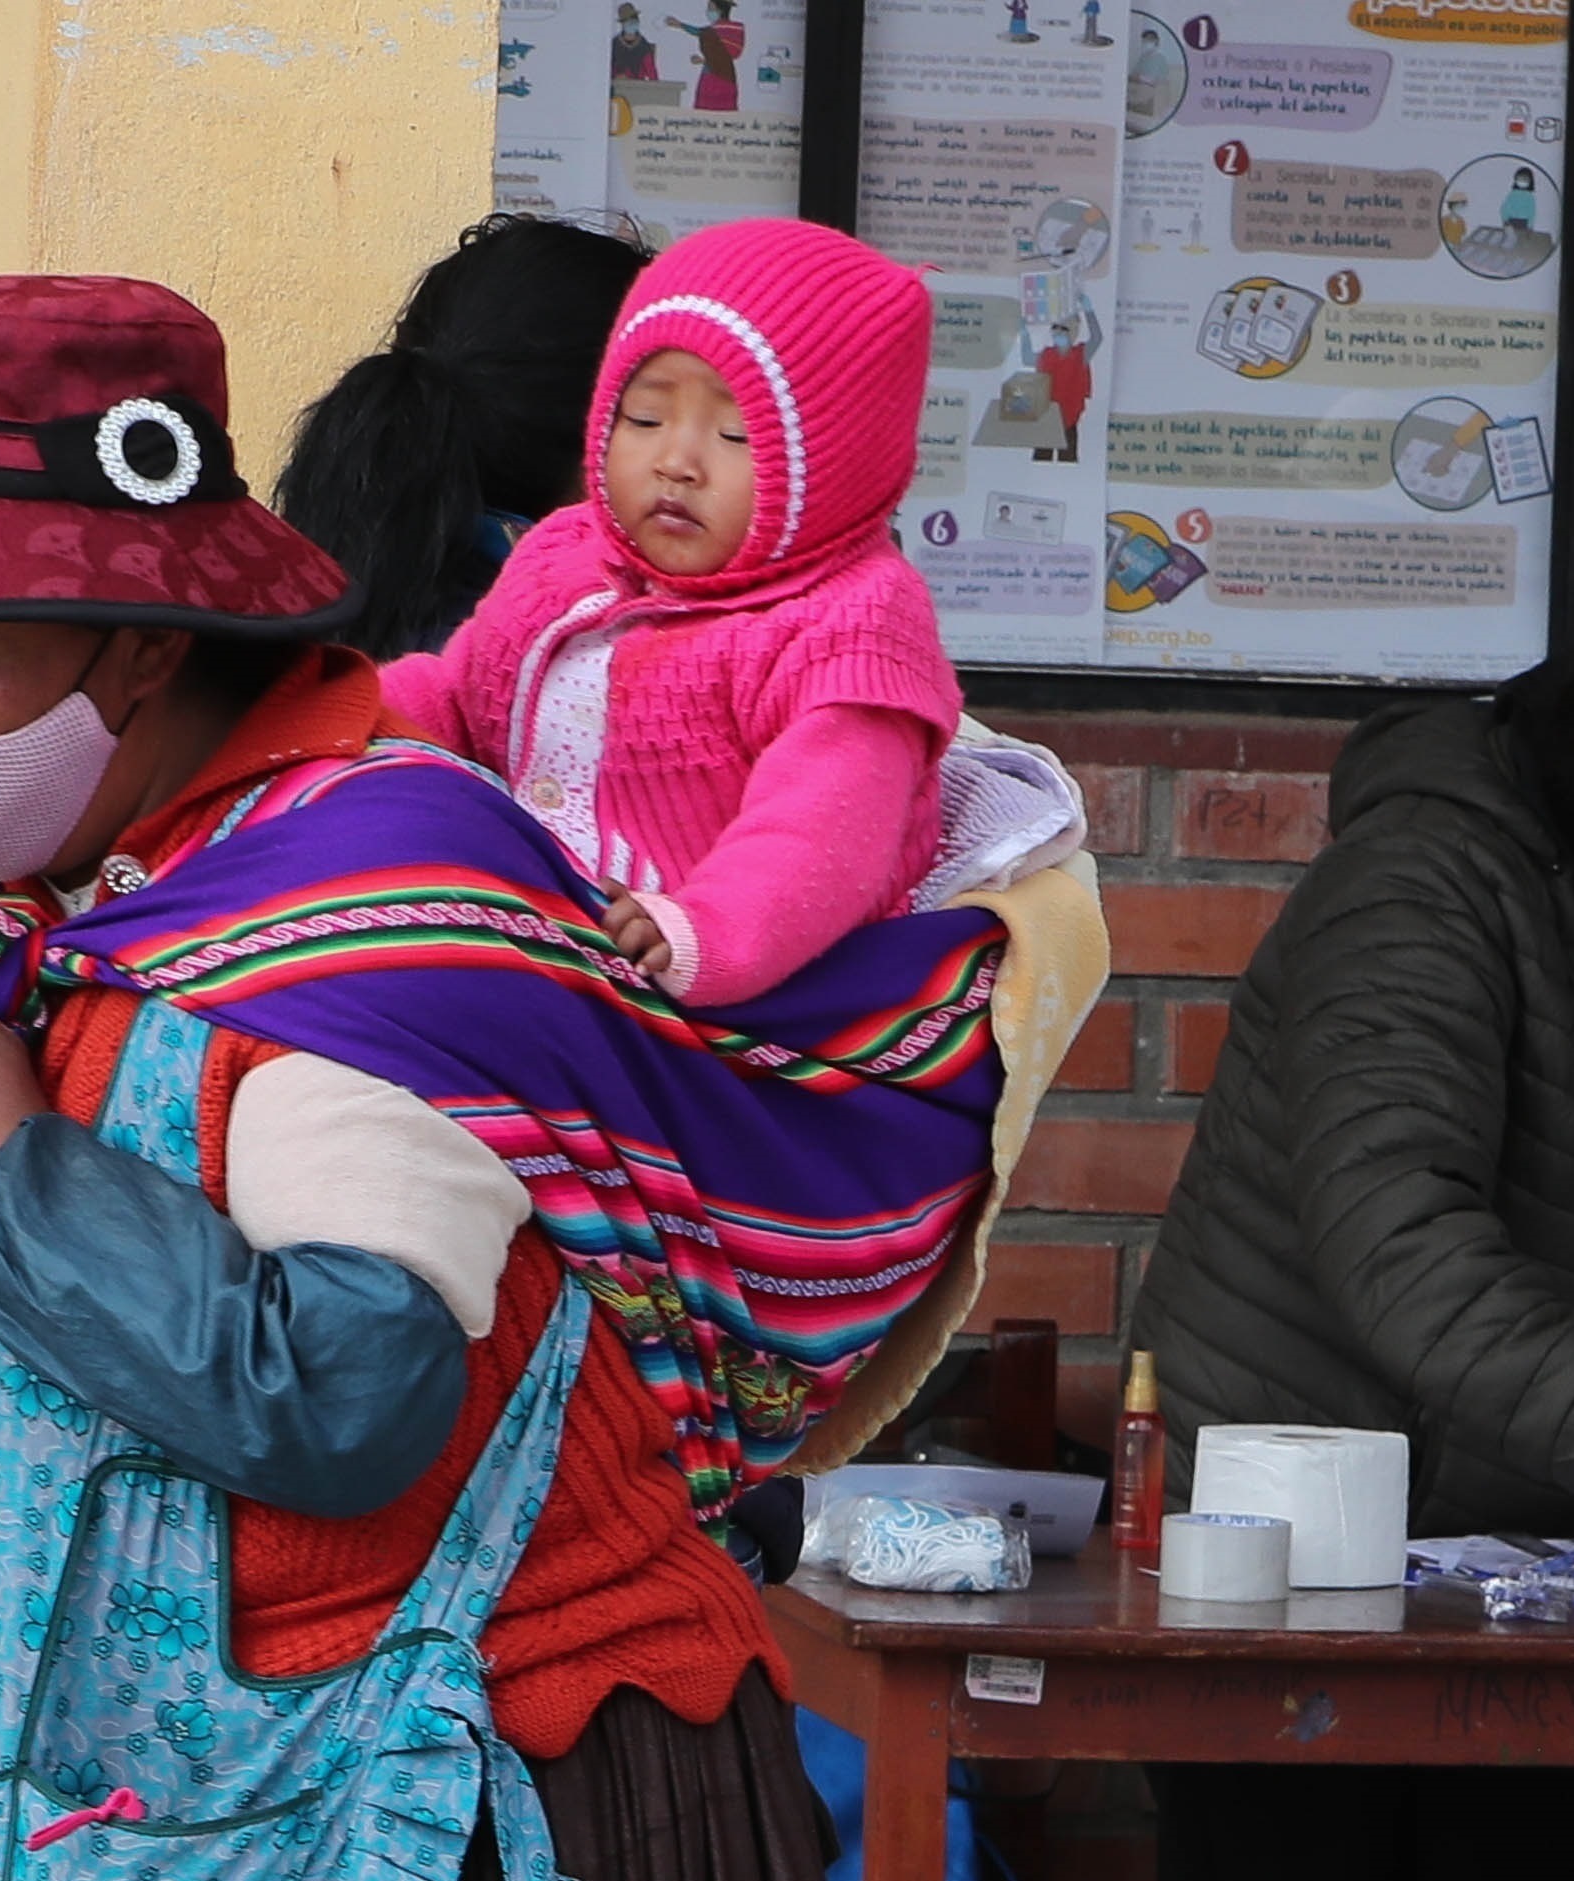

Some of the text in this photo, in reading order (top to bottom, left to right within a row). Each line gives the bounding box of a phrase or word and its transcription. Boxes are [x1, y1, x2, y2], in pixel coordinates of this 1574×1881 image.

[1224, 53, 1288, 72] Presidenta
[1309, 57, 1373, 76] Presidente
[1311, 79, 1371, 97] papeletas
[1343, 192, 1404, 210] papeletas
[1348, 331, 1408, 347] papeletas
[1169, 420, 1201, 435] total
[1228, 423, 1288, 441] papeletas
[931, 512, 949, 543] 6
